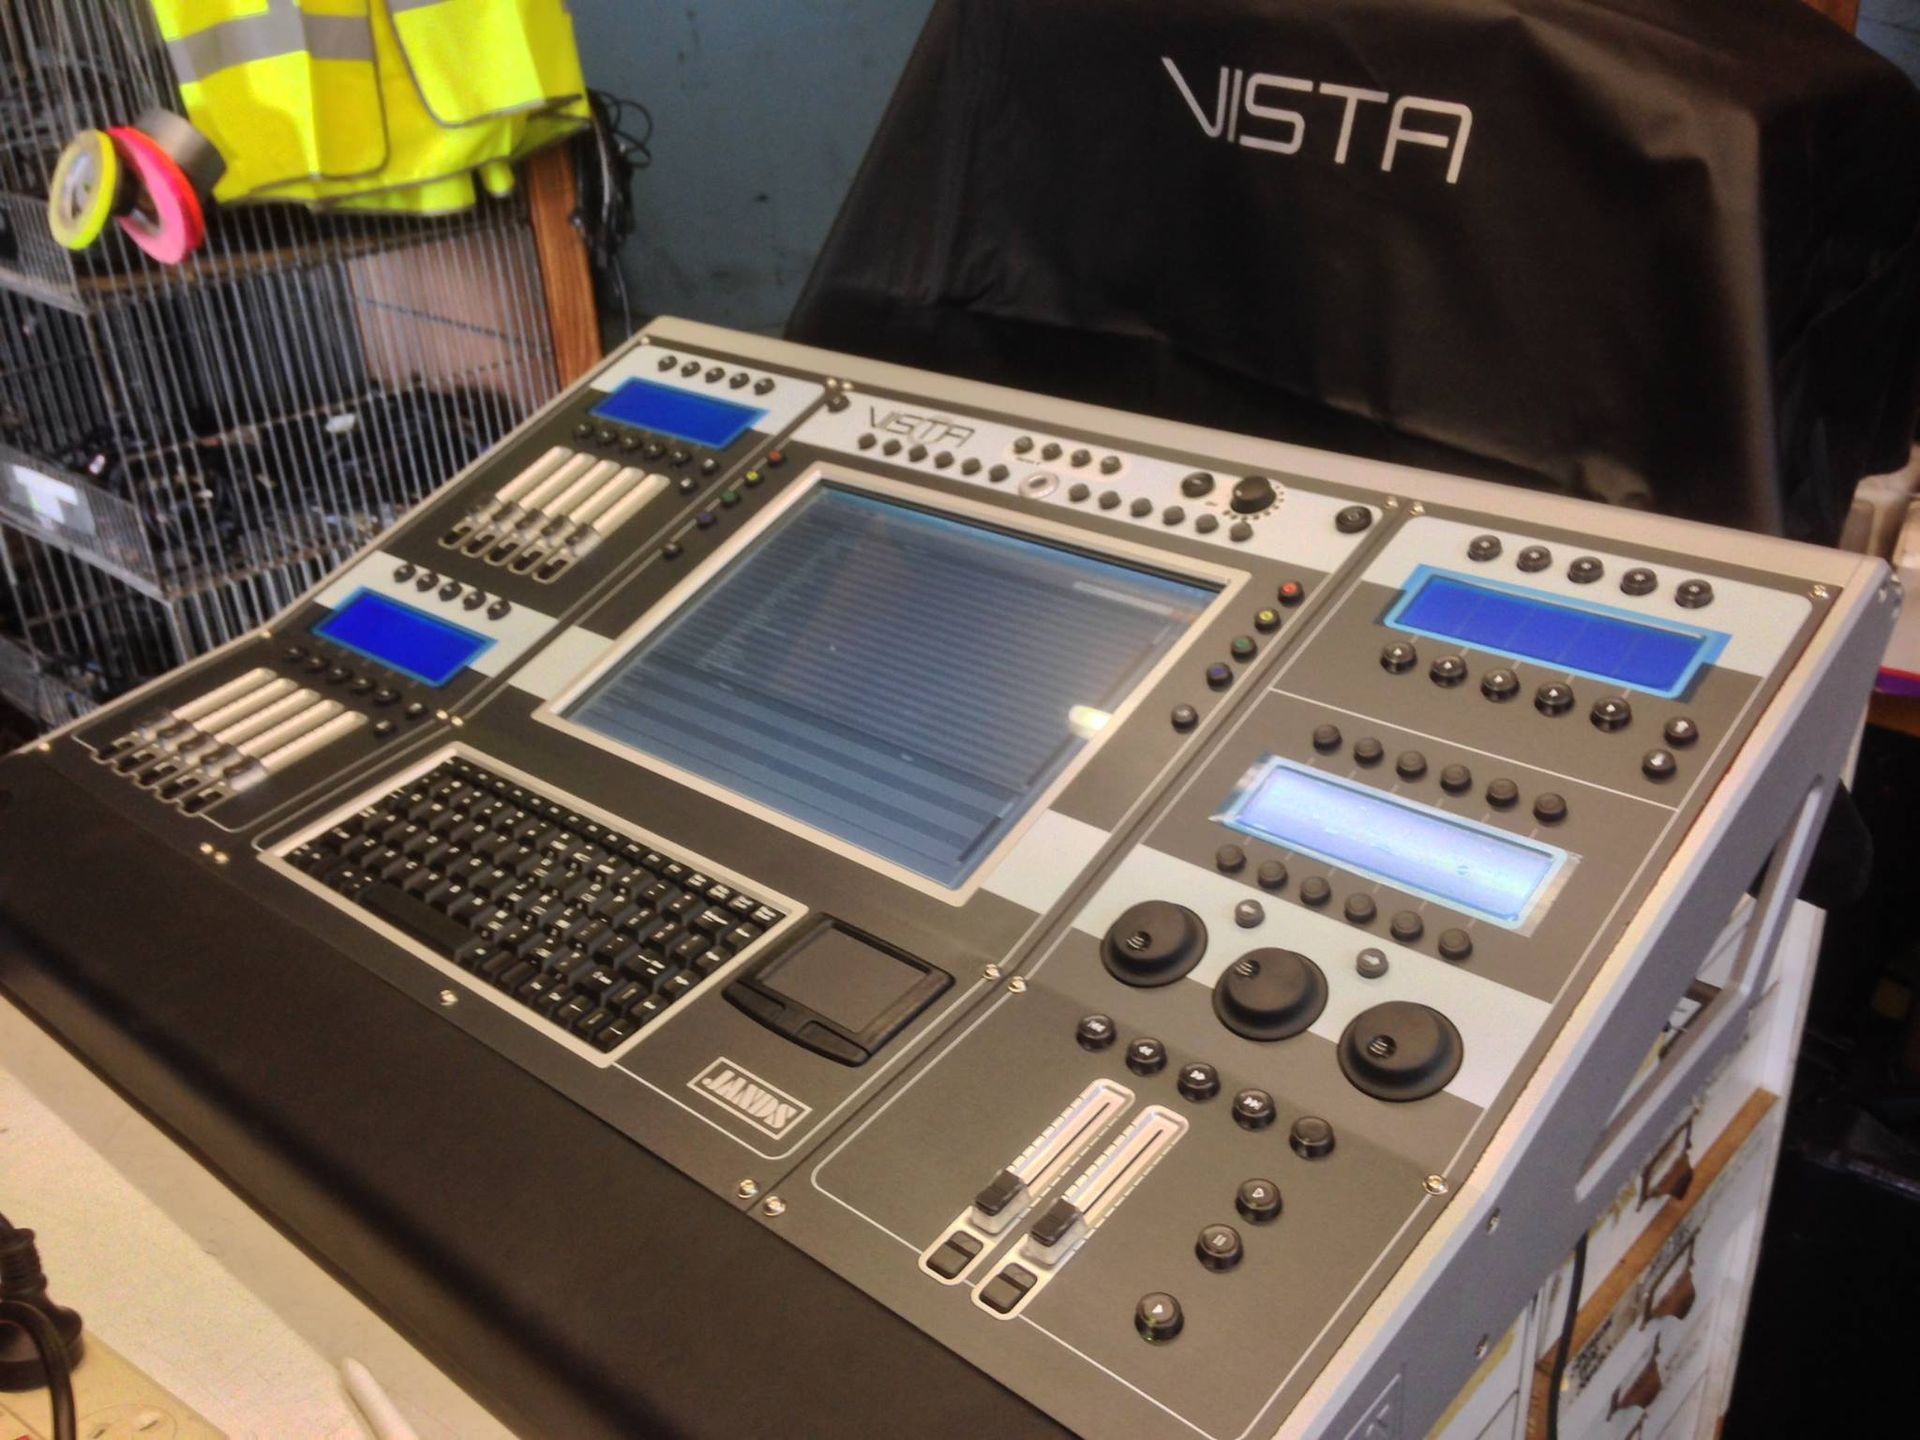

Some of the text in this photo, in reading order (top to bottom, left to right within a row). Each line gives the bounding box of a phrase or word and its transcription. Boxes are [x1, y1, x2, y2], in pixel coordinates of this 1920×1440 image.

[1161, 56, 1473, 185] VISTA
[870, 406, 975, 448] VISTA
[701, 1069, 798, 1129] JANDS
